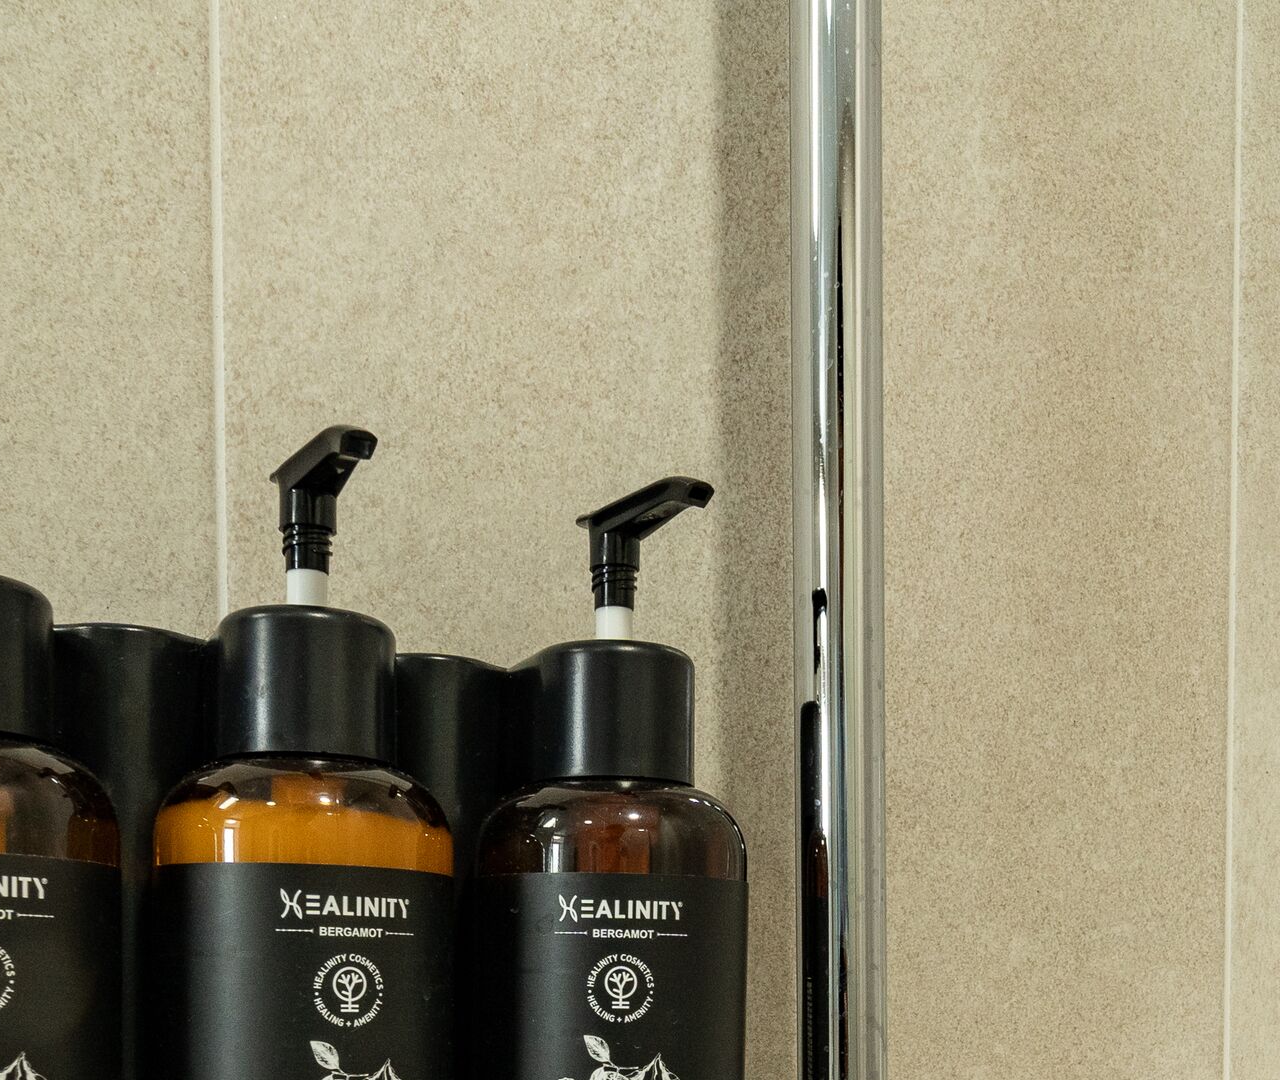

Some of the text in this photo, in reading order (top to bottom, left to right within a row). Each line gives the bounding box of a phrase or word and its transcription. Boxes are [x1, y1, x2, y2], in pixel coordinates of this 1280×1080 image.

[319, 926, 383, 938] BERGAMOT
[592, 929, 655, 939] BERGAMOT
[313, 953, 384, 990] HEALINITY COSMETICS
[586, 953, 655, 989] HEALINITY COSMETICS
[313, 997, 383, 1028] HEALING AMENITY
[587, 994, 654, 1023] HEALING AMENITY
